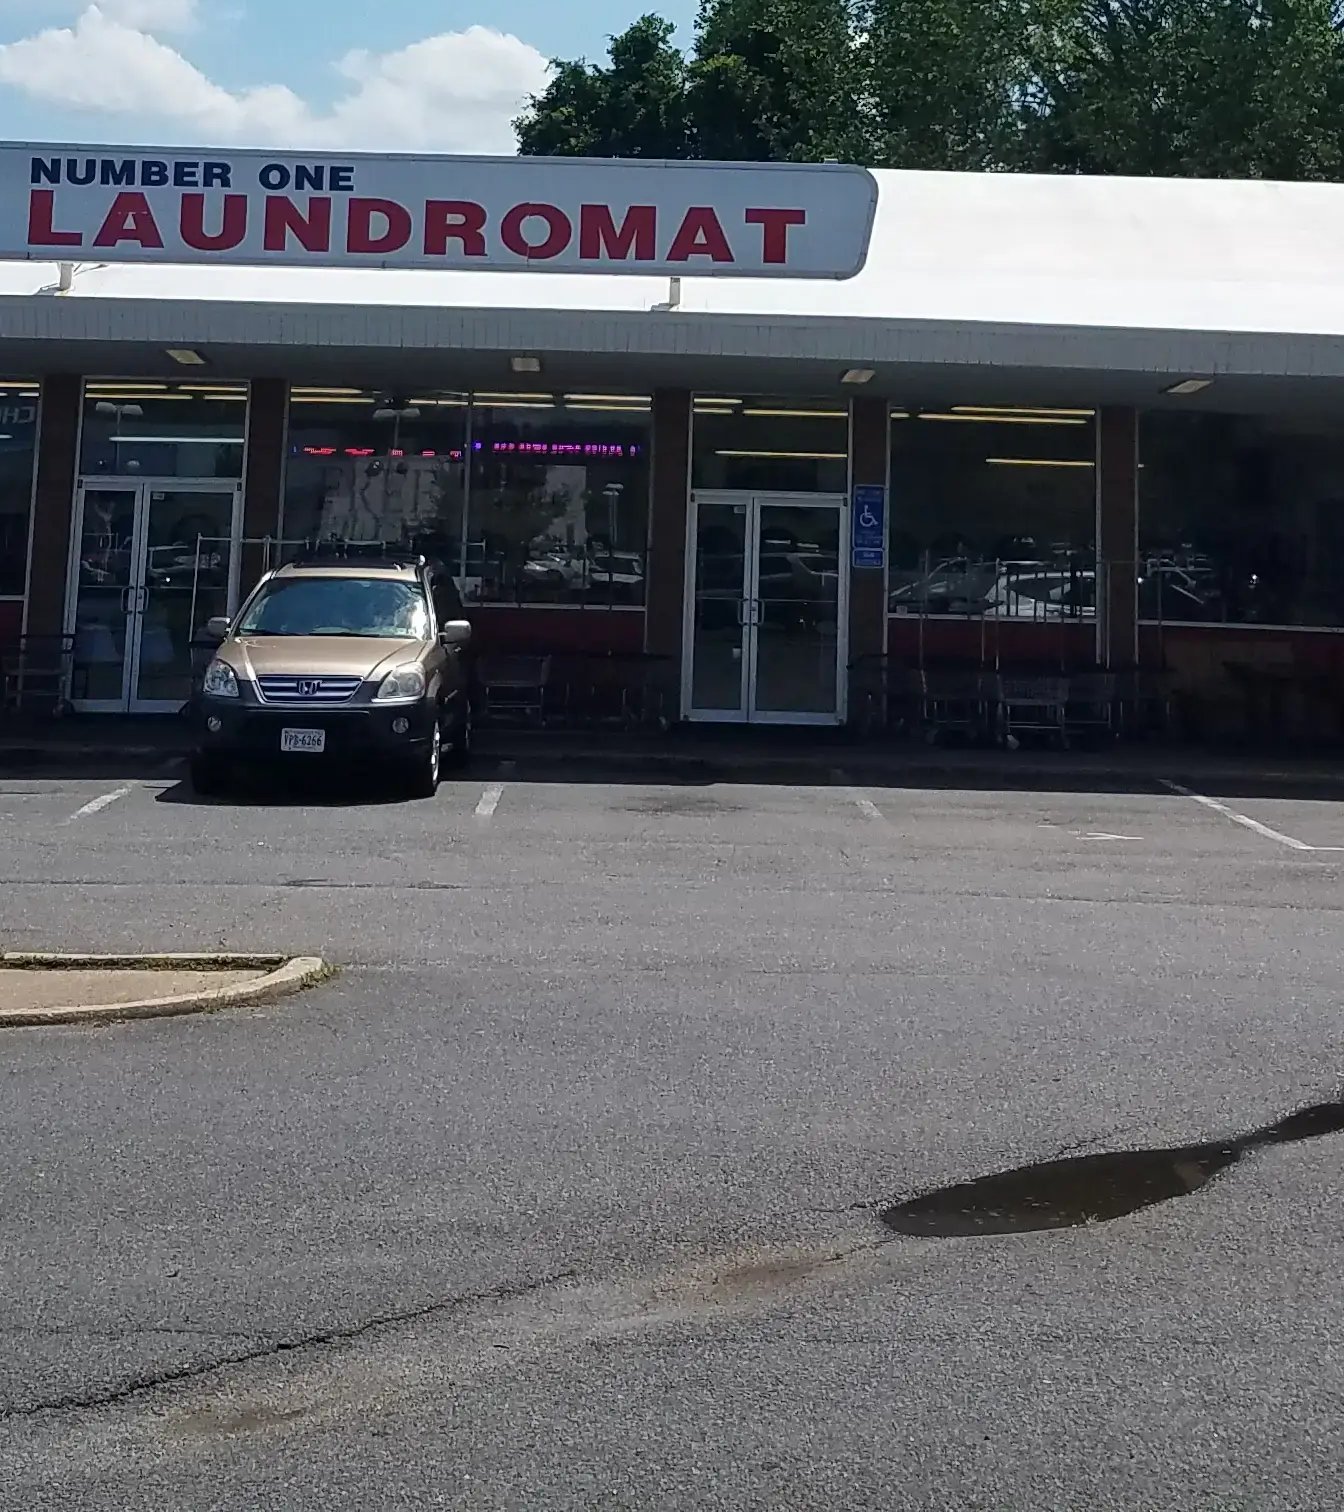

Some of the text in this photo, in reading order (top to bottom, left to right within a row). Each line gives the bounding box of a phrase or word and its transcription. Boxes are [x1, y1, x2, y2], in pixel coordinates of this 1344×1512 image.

[30, 157, 355, 191] NUMBER ONE
[27, 189, 807, 264] LAUNDROMAT
